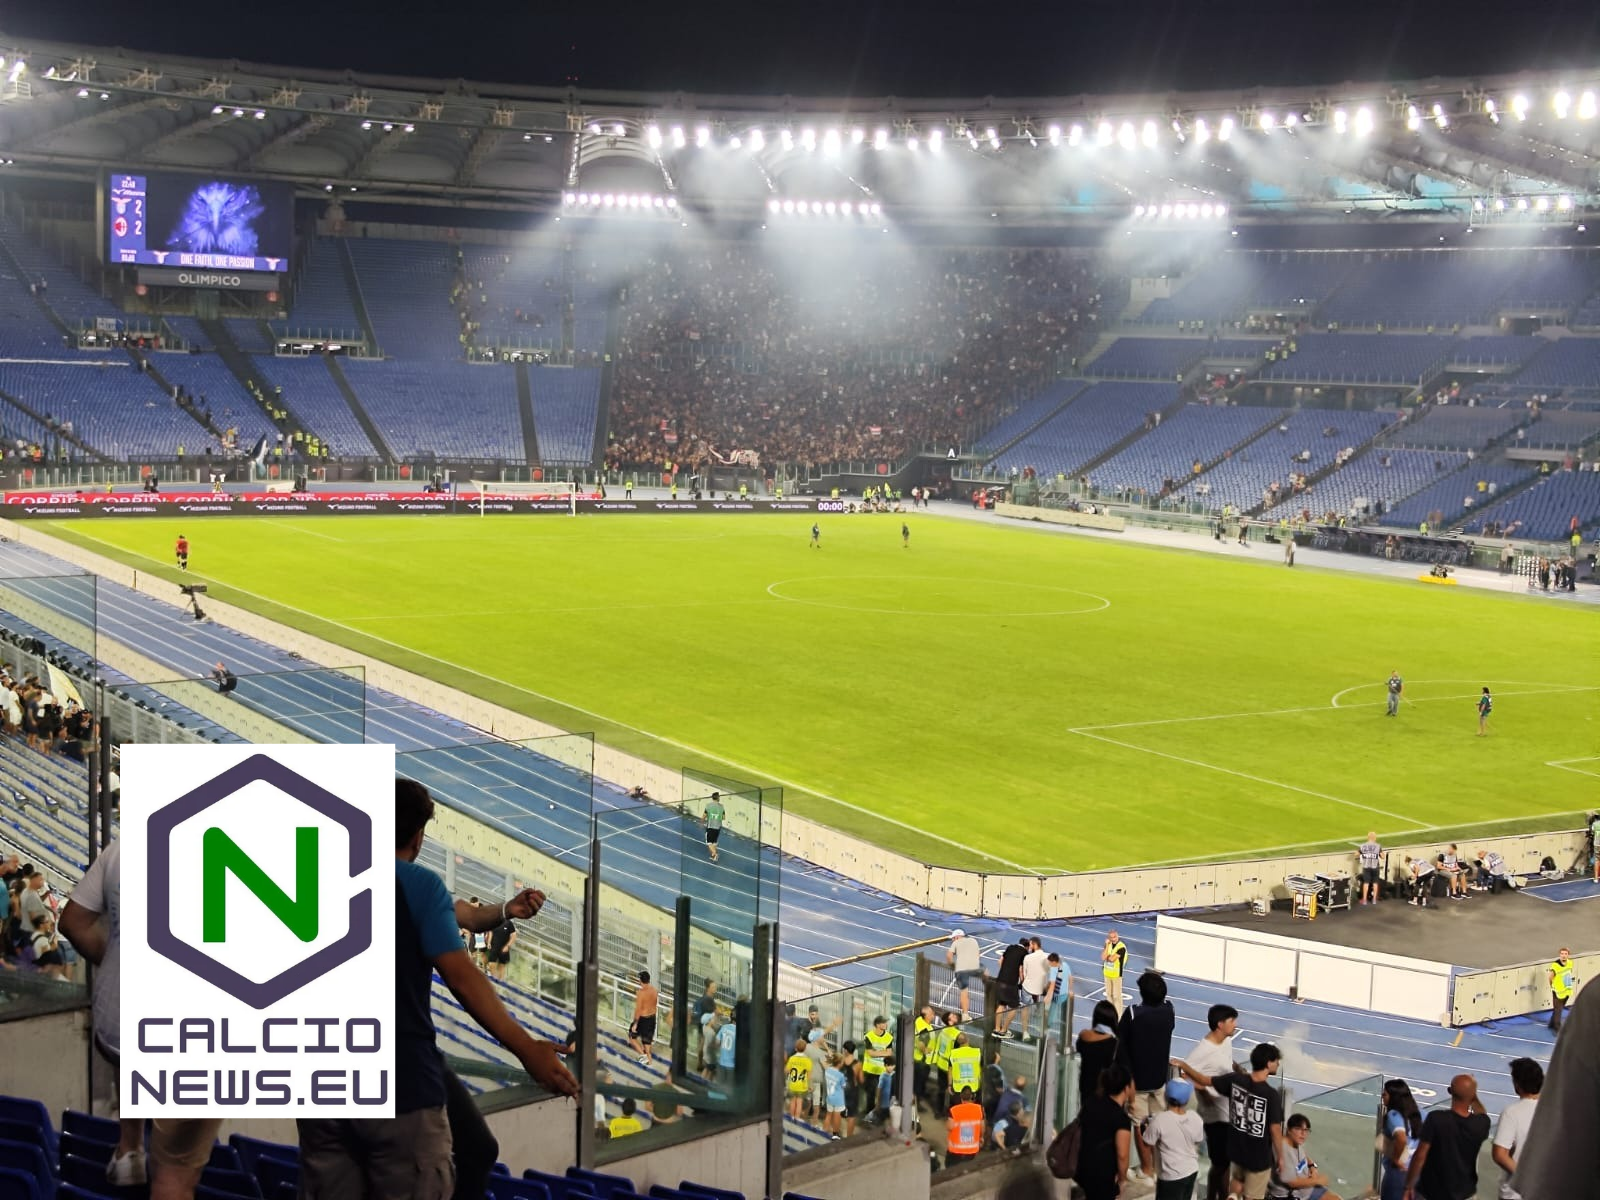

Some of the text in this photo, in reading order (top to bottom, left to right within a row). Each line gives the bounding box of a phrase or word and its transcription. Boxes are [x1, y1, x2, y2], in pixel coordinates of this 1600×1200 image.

[135, 199, 142, 215] 2
[135, 220, 142, 235] 2
[178, 273, 241, 287] OLIMPICO
[947, 447, 956, 458] A
[818, 502, 843, 511] 00:00
